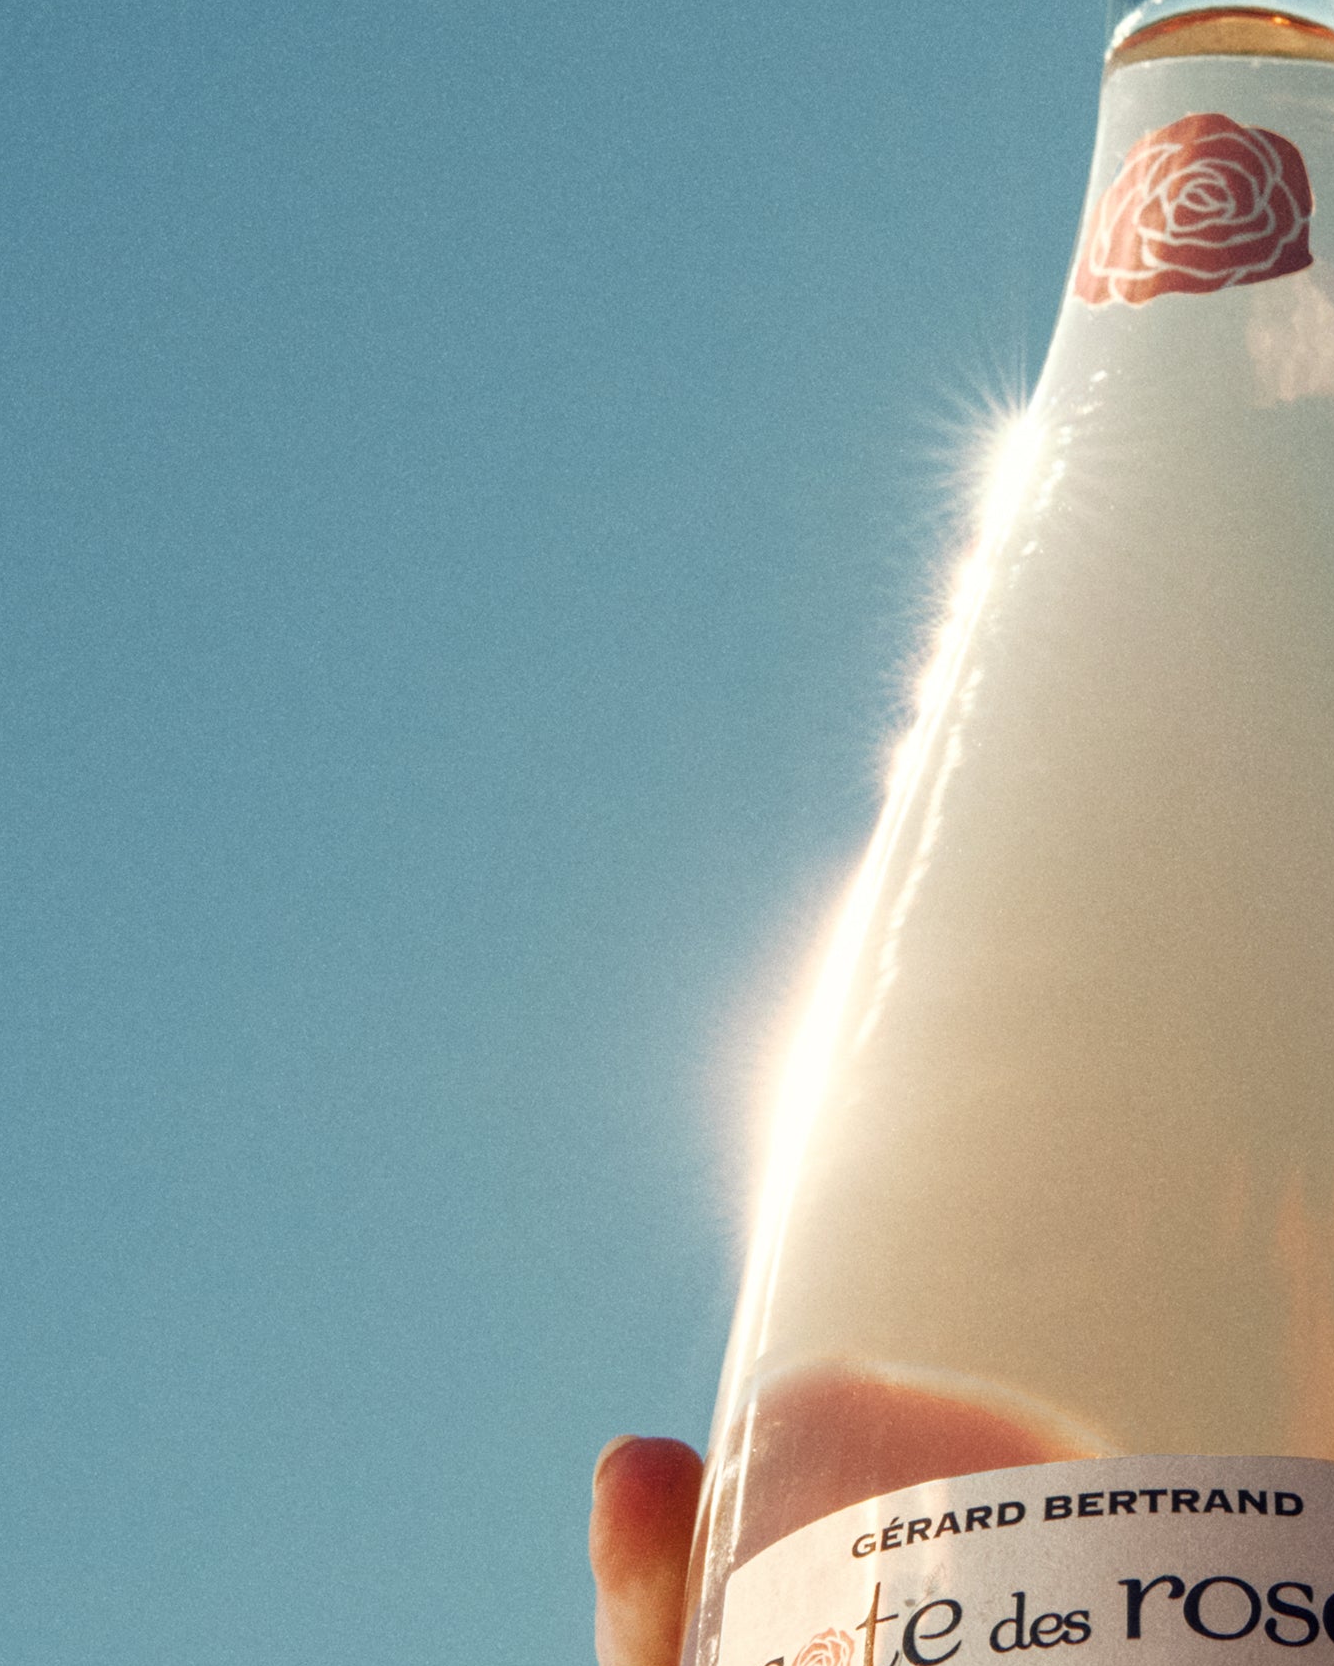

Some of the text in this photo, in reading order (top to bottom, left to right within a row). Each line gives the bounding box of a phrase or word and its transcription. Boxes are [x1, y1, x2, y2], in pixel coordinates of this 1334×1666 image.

[851, 1488, 1304, 1559] GÉRARD BERTRAND
[989, 1591, 1092, 1654] des
